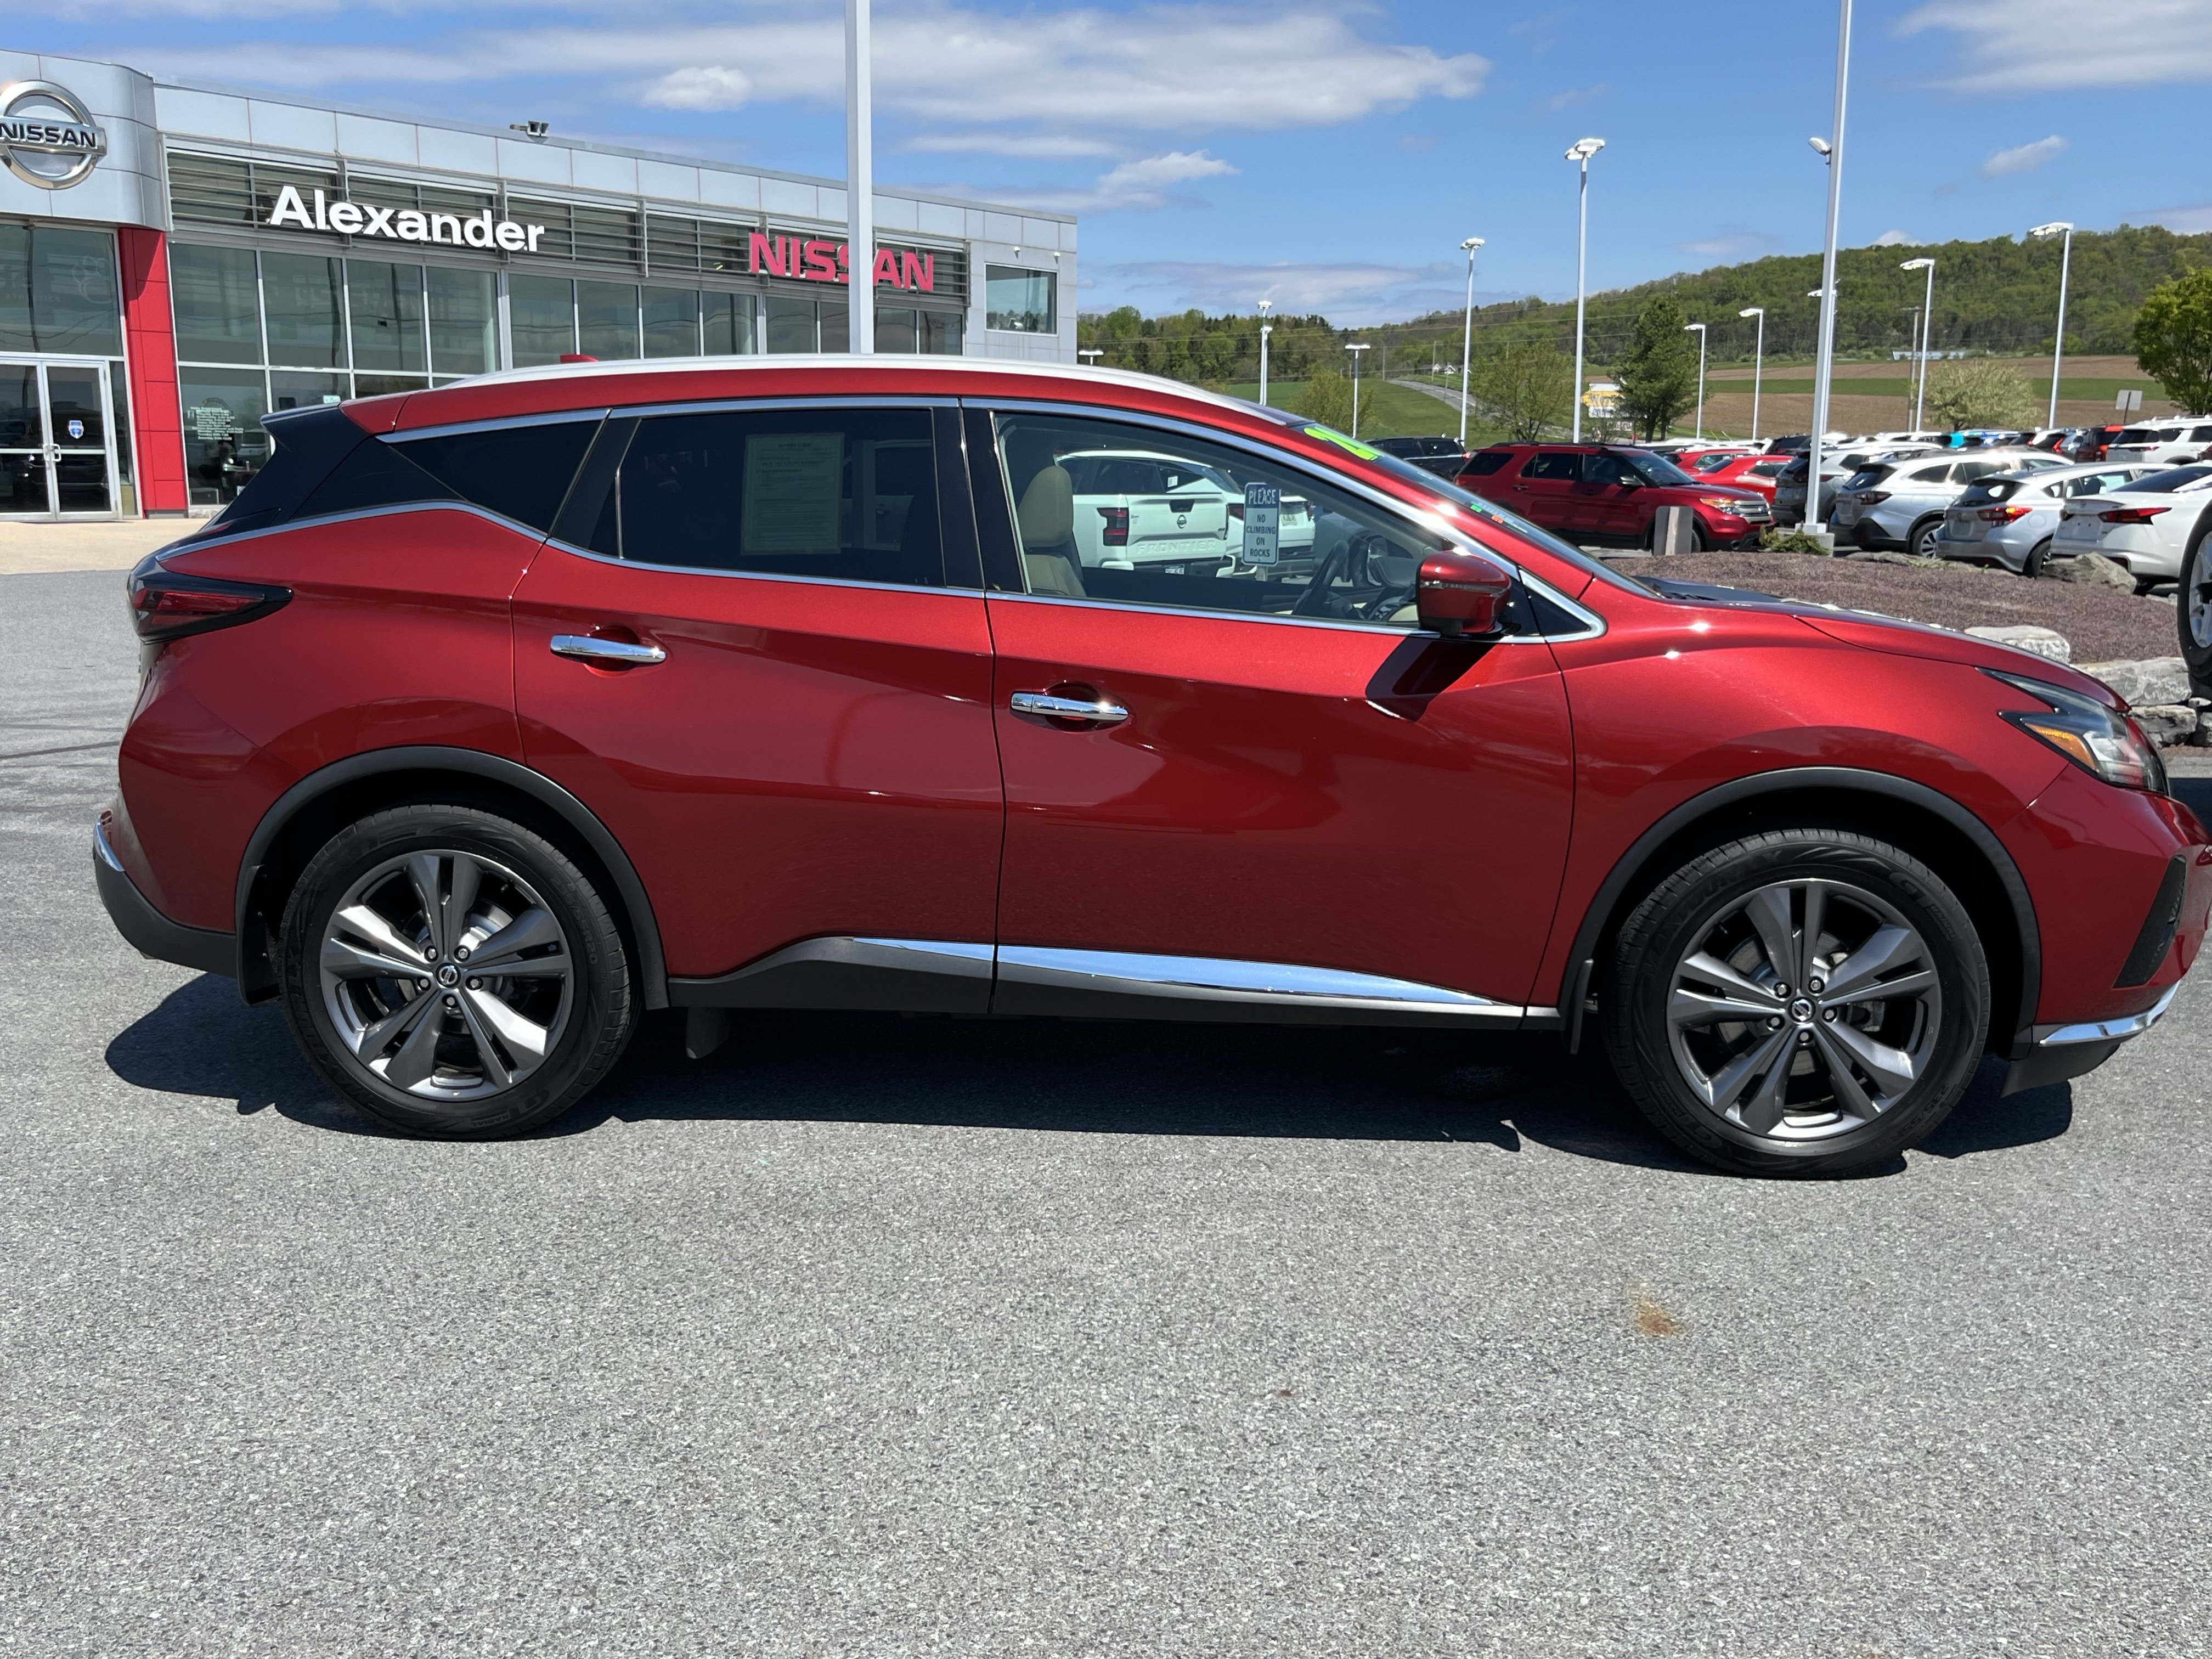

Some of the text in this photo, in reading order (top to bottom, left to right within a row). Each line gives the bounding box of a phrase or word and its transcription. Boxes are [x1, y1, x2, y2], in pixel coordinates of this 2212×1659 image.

[0, 122, 97, 148] NISSAN
[269, 185, 545, 252] Alexander
[1248, 488, 1277, 505] PLEASE
[1257, 514, 1266, 523] NO
[1246, 526, 1276, 534] CLIMBING
[1137, 540, 1216, 554] FRONTIER
[1256, 537, 1265, 546] ON
[1250, 548, 1270, 557] ROCKS
